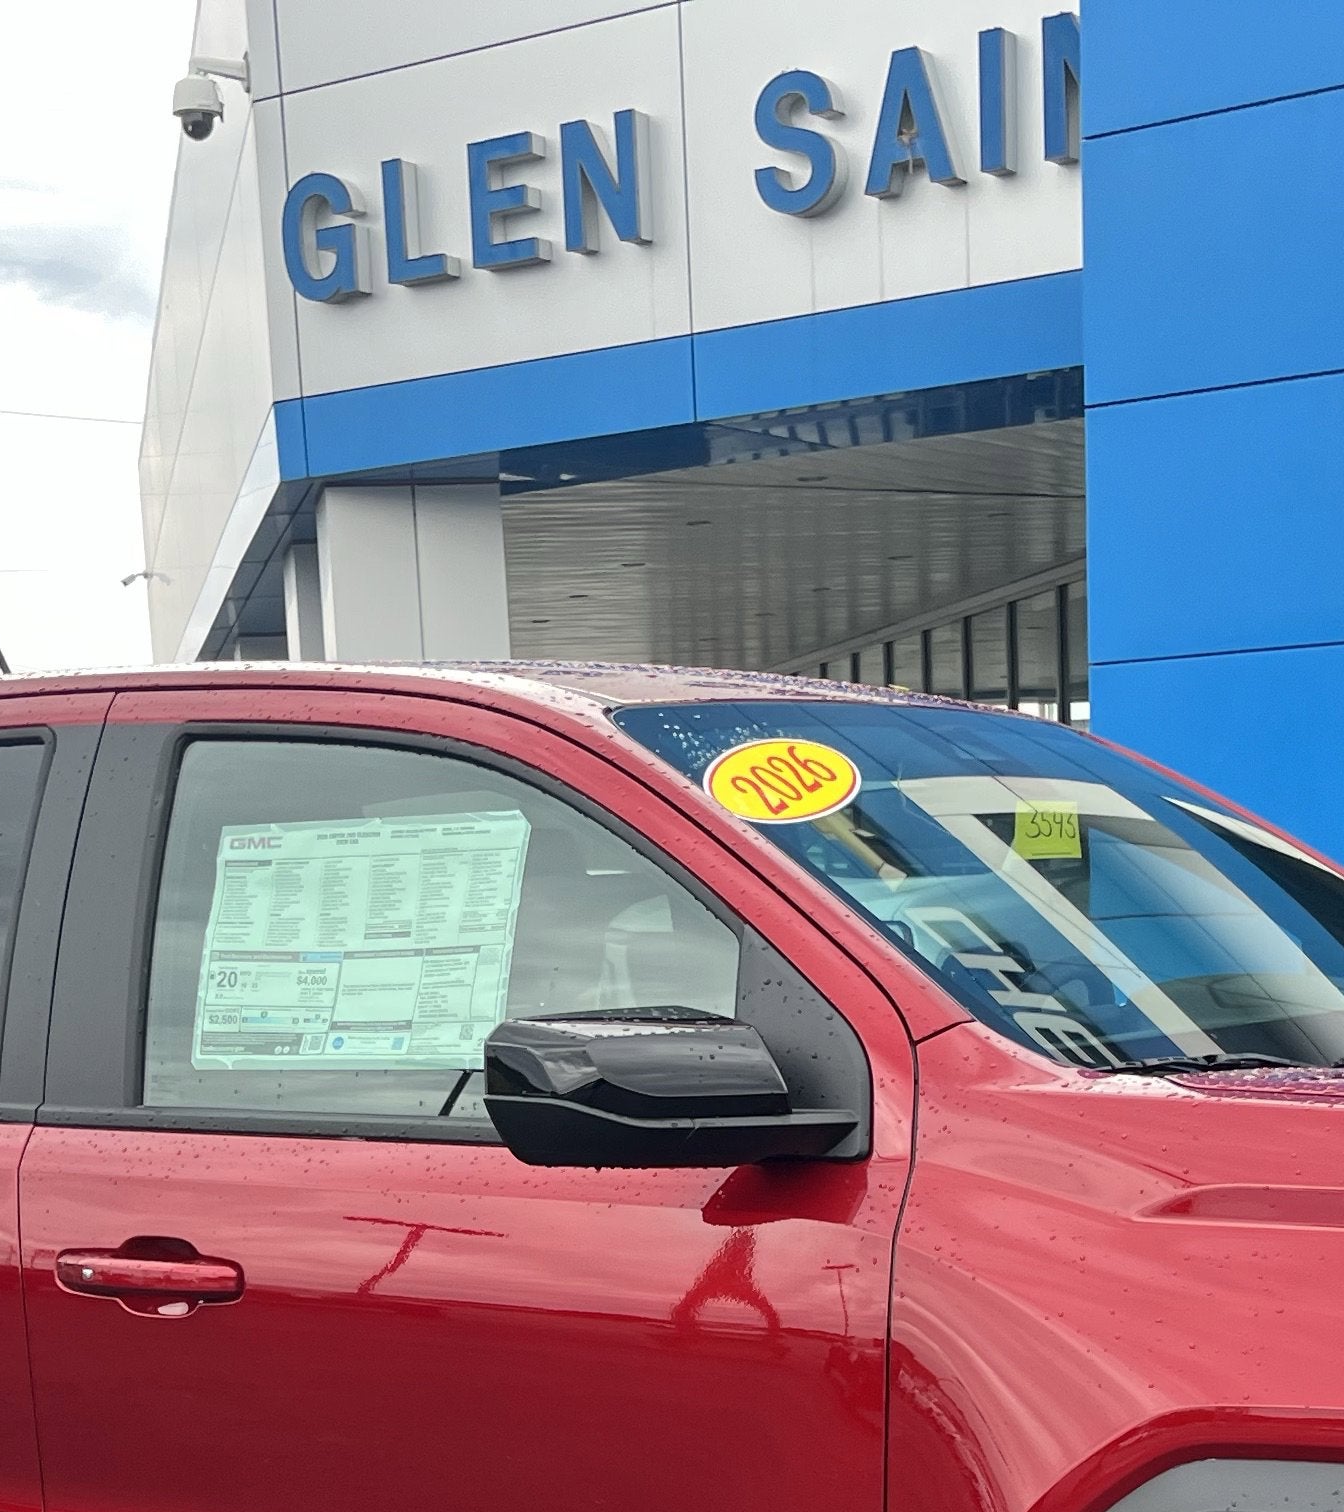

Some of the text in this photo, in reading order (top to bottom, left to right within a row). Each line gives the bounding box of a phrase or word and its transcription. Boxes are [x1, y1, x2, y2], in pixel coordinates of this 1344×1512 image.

[282, 109, 652, 304] GLEN
[730, 745, 837, 815] 2026
[229, 836, 283, 850] GMC
[216, 971, 238, 989] 20
[208, 1014, 238, 1025] $2,500
